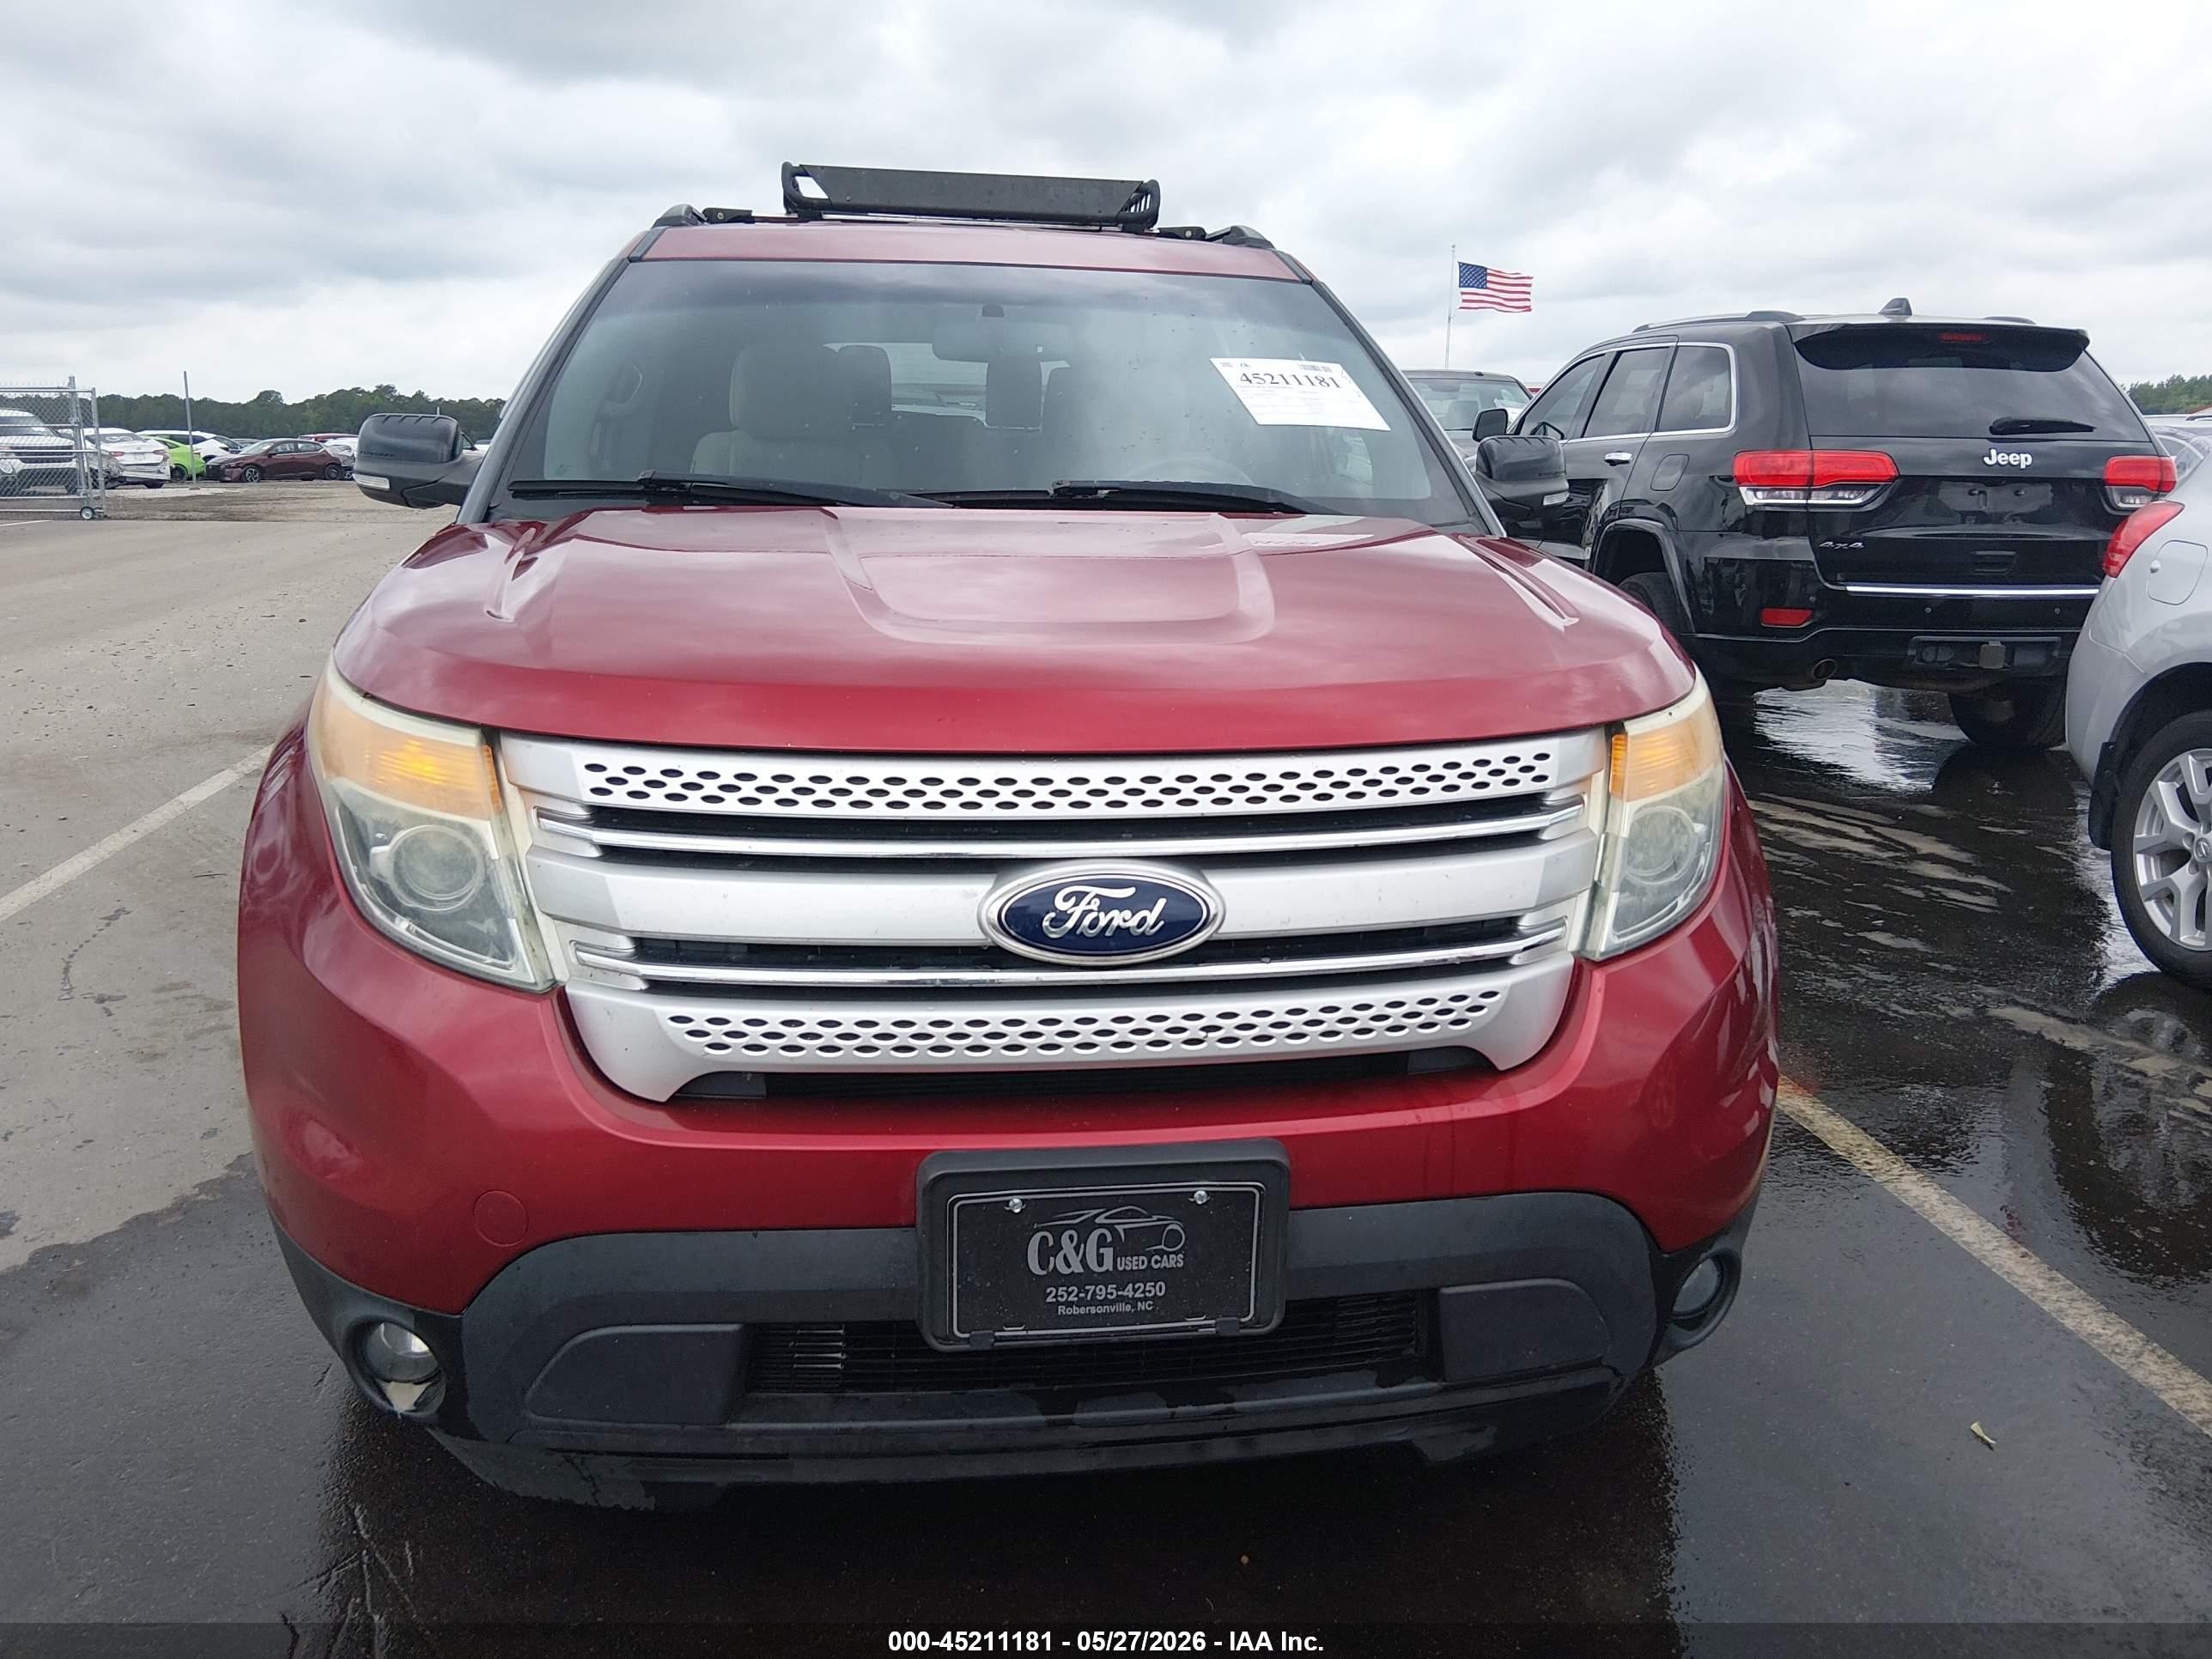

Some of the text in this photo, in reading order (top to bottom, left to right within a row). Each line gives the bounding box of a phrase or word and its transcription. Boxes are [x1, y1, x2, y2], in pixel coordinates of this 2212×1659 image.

[1239, 372, 1342, 389] 45211181
[1984, 448, 2033, 470] Jeep
[1042, 884, 1167, 939] Ford
[1027, 1228, 1184, 1276] C&G USED CARS
[1046, 1281, 1166, 1303] 252-795-4250
[1057, 1300, 1154, 1316] Robersonville, NC
